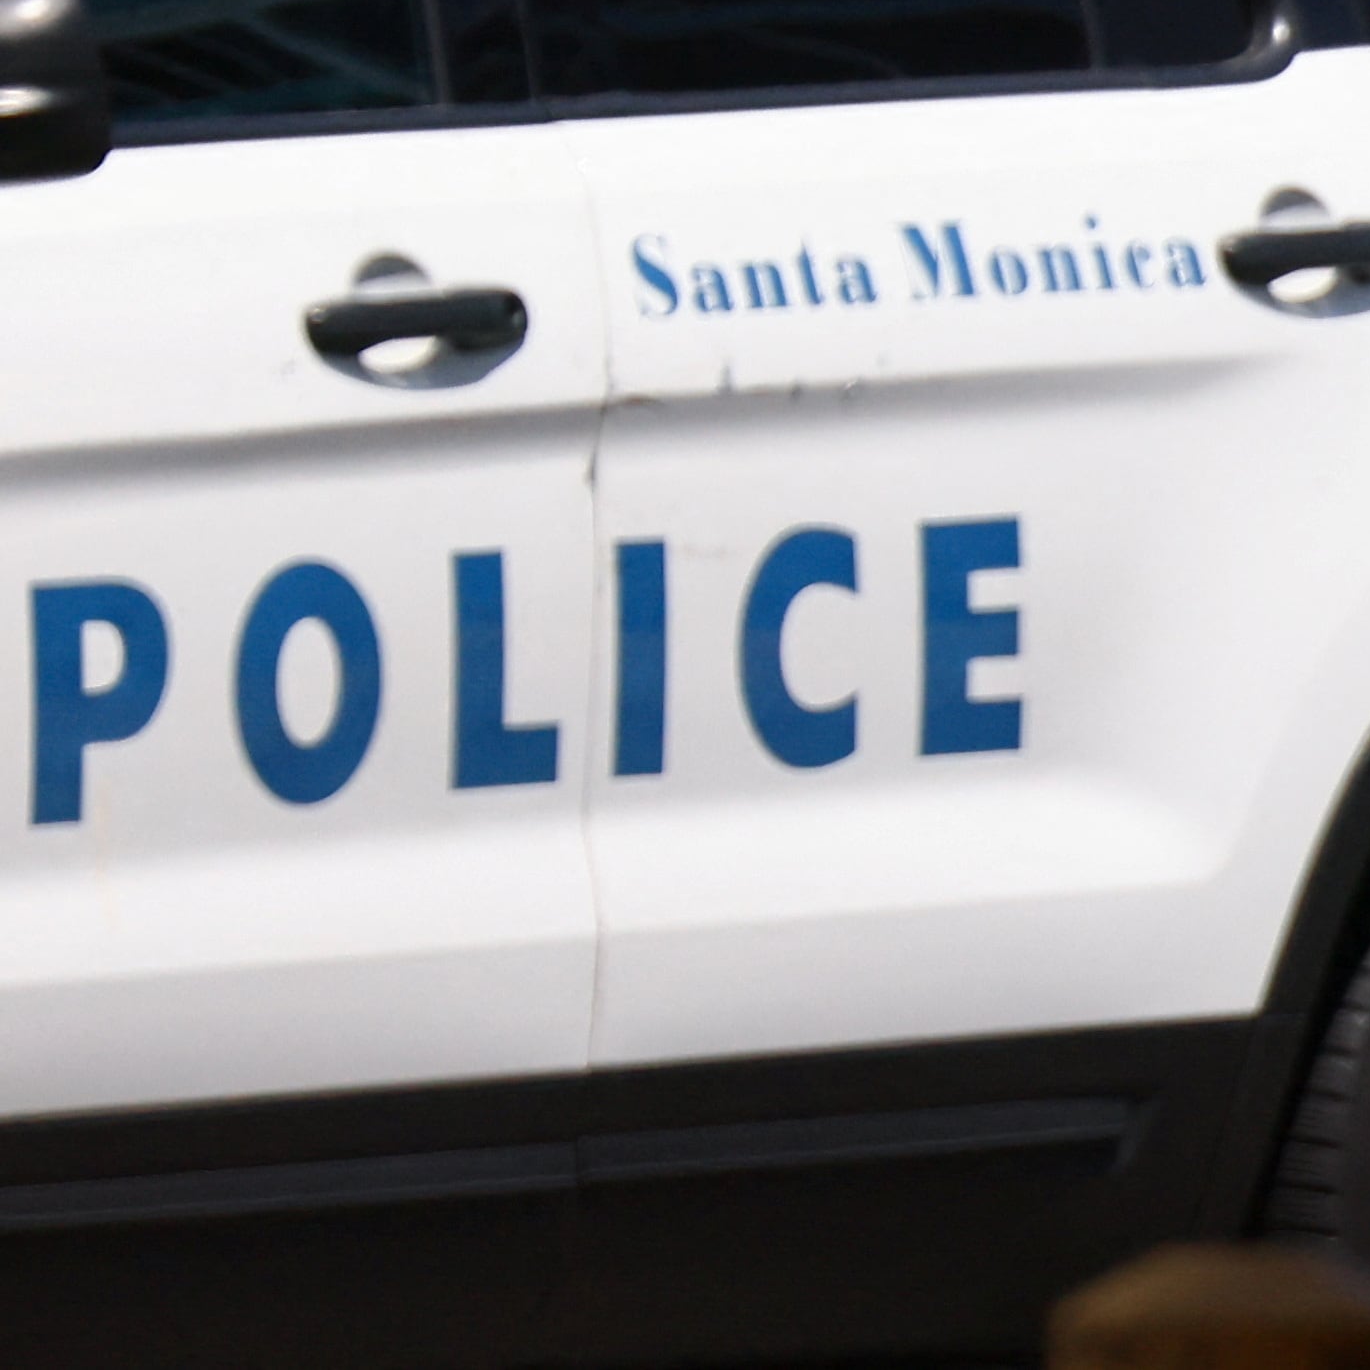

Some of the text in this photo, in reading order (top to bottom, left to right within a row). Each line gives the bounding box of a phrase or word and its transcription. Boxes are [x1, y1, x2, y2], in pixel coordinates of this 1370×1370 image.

[630, 212, 1208, 317] Santa Monica
[28, 516, 1023, 826] POLICE
